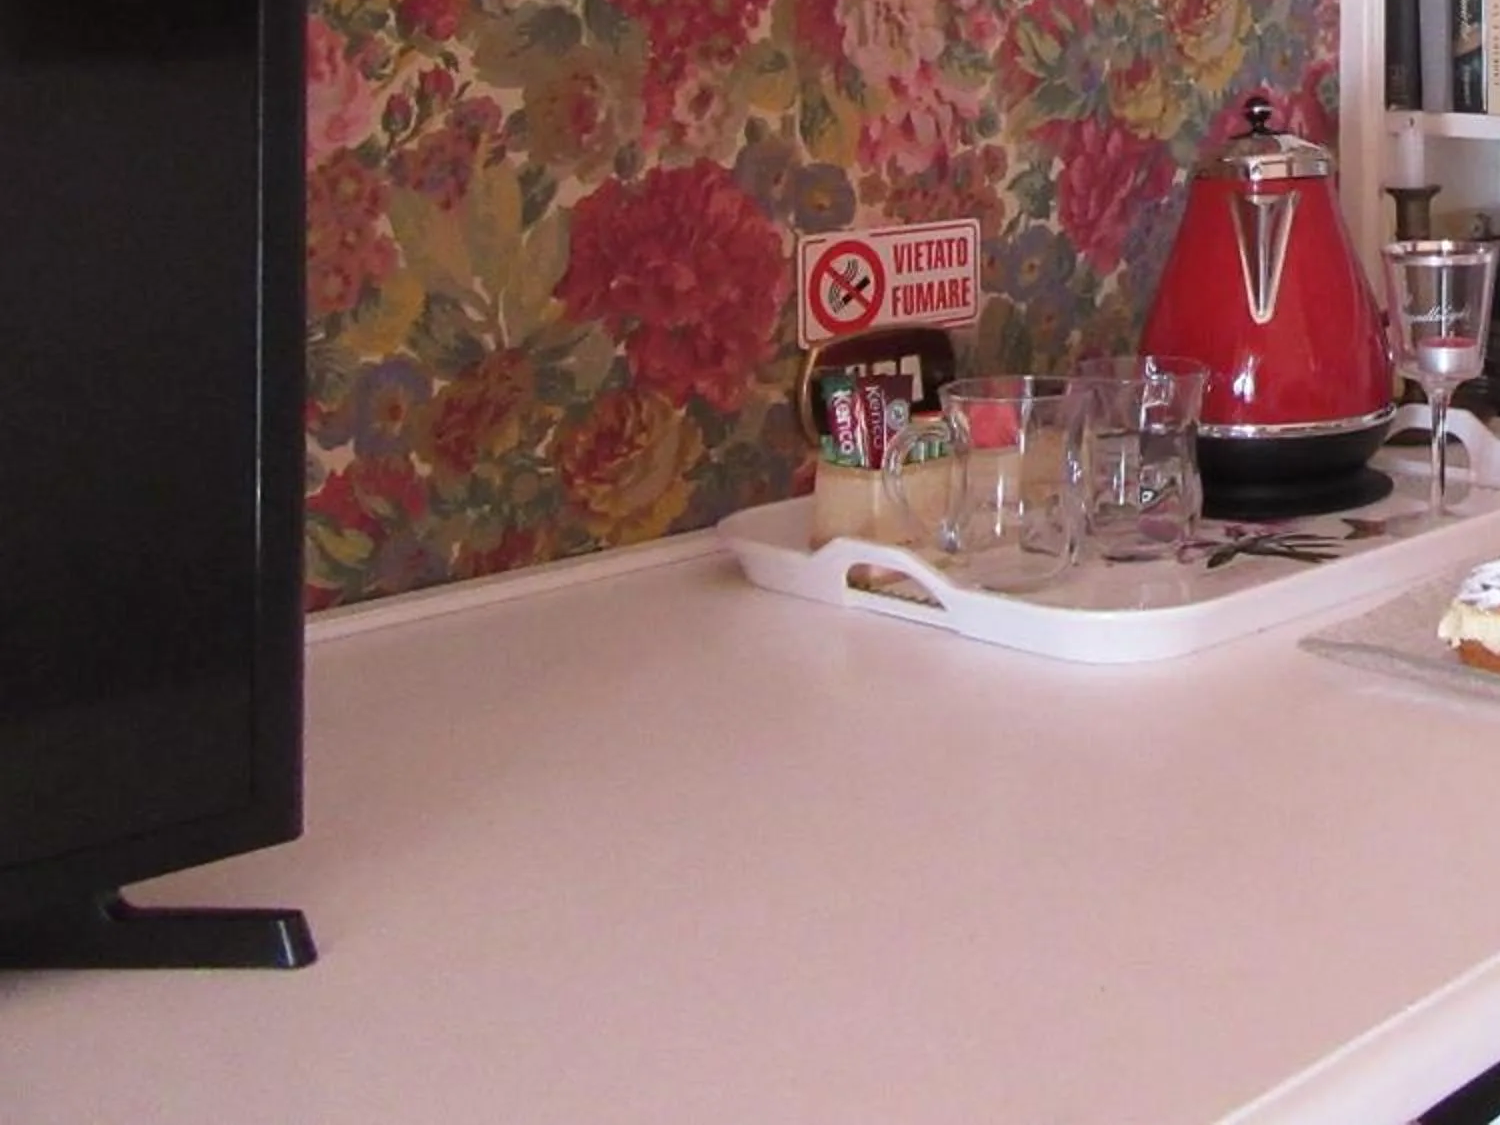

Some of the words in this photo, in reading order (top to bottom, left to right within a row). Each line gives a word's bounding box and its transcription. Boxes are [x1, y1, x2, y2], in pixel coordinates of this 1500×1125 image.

[893, 237, 968, 274] VIETATO
[892, 277, 971, 317] FUMARE
[831, 389, 854, 455] Kenco
[864, 386, 882, 449] Kenco
